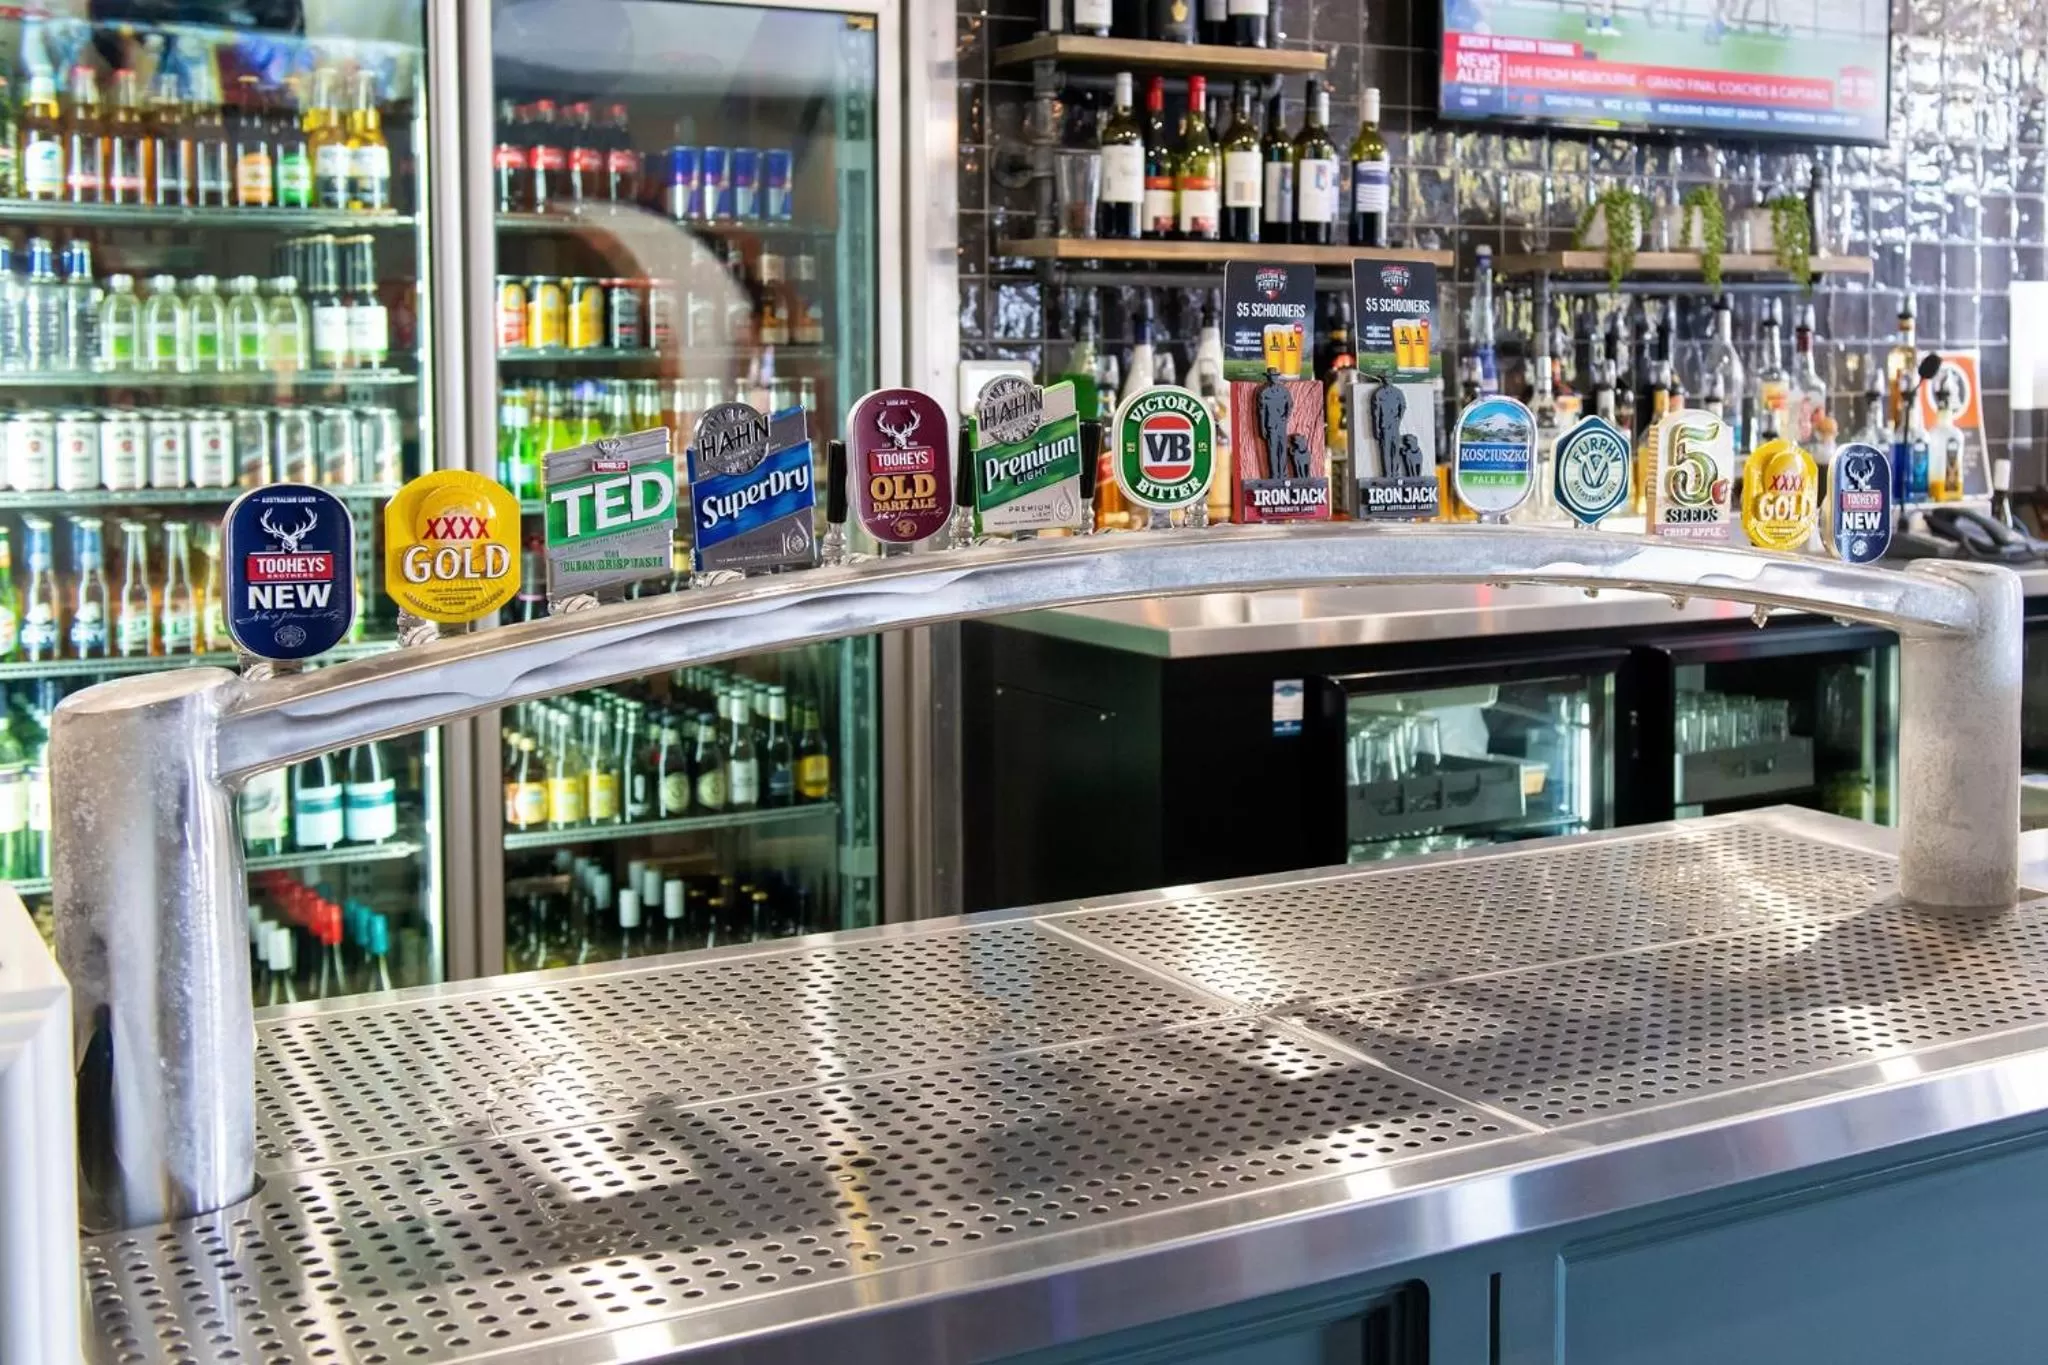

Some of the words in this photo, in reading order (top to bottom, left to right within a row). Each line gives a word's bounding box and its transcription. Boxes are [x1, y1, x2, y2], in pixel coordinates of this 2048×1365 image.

[1456, 51, 1501, 68] NEWS
[1456, 67, 1500, 84] ALERT
[1509, 65, 1533, 79] LIVE
[1535, 66, 1569, 81] FROM
[1571, 69, 1636, 86] MELBOURNE
[1645, 75, 1685, 90] GRAND
[1688, 78, 1717, 93] FINAL
[1719, 81, 1768, 97] COACHES
[1236, 302, 1250, 317] $5
[1251, 303, 1306, 318] SCHOONERS
[1366, 298, 1378, 312] $5
[1380, 299, 1430, 313] SCHOONERS
[980, 388, 1043, 432] HAHN
[1129, 395, 1205, 425] VICTORIA
[701, 415, 771, 462] HAHN
[1143, 433, 1192, 462] VB
[876, 451, 929, 467] TOOHEYS
[1461, 448, 1530, 463] KOSCIUSZKO
[1572, 437, 1622, 464] FURPHY
[985, 435, 1076, 492] Premium
[1664, 421, 1720, 507] 5
[1016, 466, 1049, 486] LIGHT
[1472, 476, 1496, 485] PALE
[1498, 475, 1517, 485] ALE
[702, 465, 809, 529] SuperDry
[870, 474, 937, 501] OLD
[1135, 476, 1202, 499] BITTER
[1254, 488, 1290, 506] IRON
[1291, 487, 1328, 505] JACK
[1368, 487, 1402, 505] IRON
[1403, 486, 1437, 503] JACK
[550, 471, 674, 538] TED
[873, 500, 910, 513] DARK
[911, 498, 936, 510] ALE
[1759, 494, 1813, 521] GOLD
[1847, 492, 1880, 505] TOOHEYS
[1008, 504, 1051, 513] PREMIUM
[1665, 508, 1719, 523] SEEDS
[423, 516, 491, 540] XXXX
[1842, 512, 1882, 531] NEW
[1664, 527, 1691, 537] CRISP
[1692, 527, 1721, 537] APPLE
[256, 557, 326, 573] TOOHEYS
[403, 543, 511, 584] GOLD
[563, 559, 596, 573] CLEAN
[597, 558, 630, 570] CRISP
[631, 556, 664, 568] TASTE
[248, 584, 332, 610] NEW
